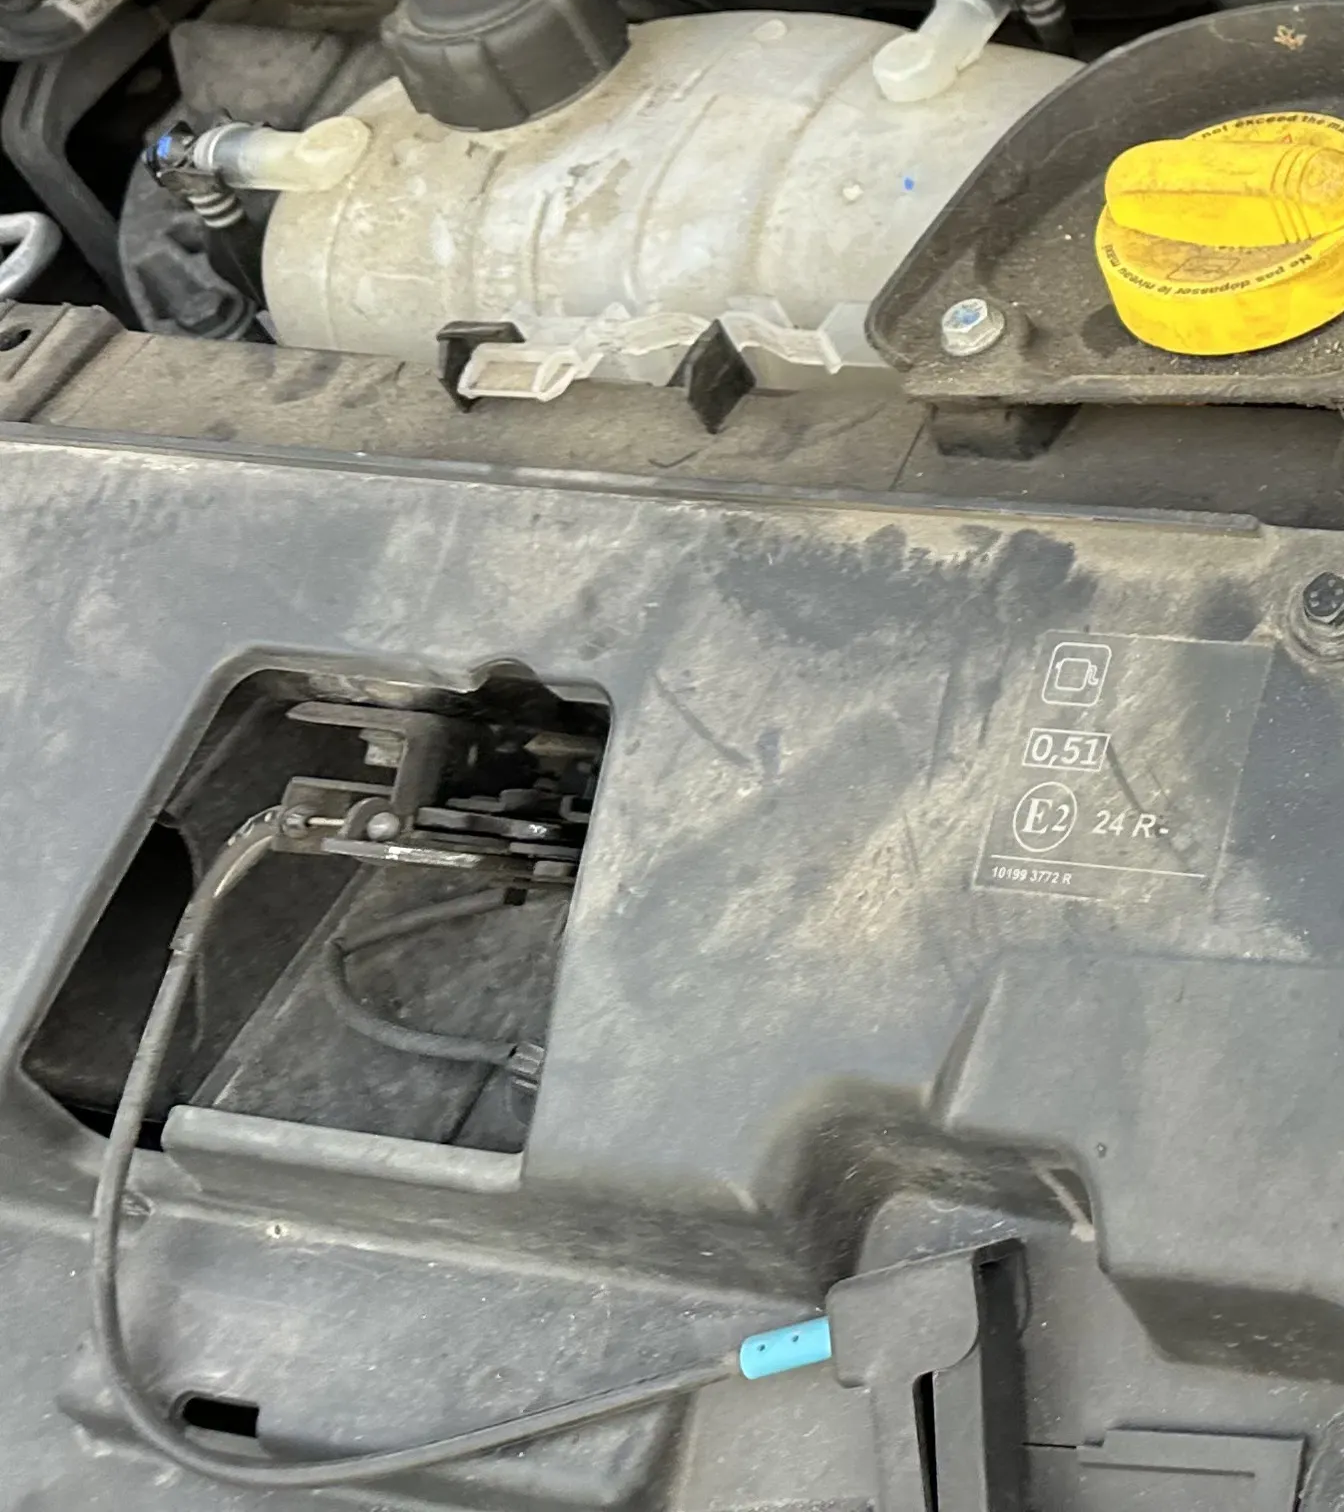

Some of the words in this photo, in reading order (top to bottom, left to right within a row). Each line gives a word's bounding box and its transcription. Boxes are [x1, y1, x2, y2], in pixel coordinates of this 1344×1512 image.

[1235, 113, 1299, 128] exceed
[1301, 114, 1327, 125] the
[1101, 244, 1121, 272] maxi
[1289, 253, 1313, 268] Ne
[1119, 267, 1156, 291] niveau
[1255, 267, 1285, 283] pas
[1157, 285, 1173, 295] le
[1031, 733, 1099, 767] 0,51
[1022, 797, 1071, 834] E2
[1092, 809, 1128, 836] 24
[992, 866, 1028, 881] 10199
[1030, 869, 1060, 884] 3772
[1062, 873, 1072, 885] R
